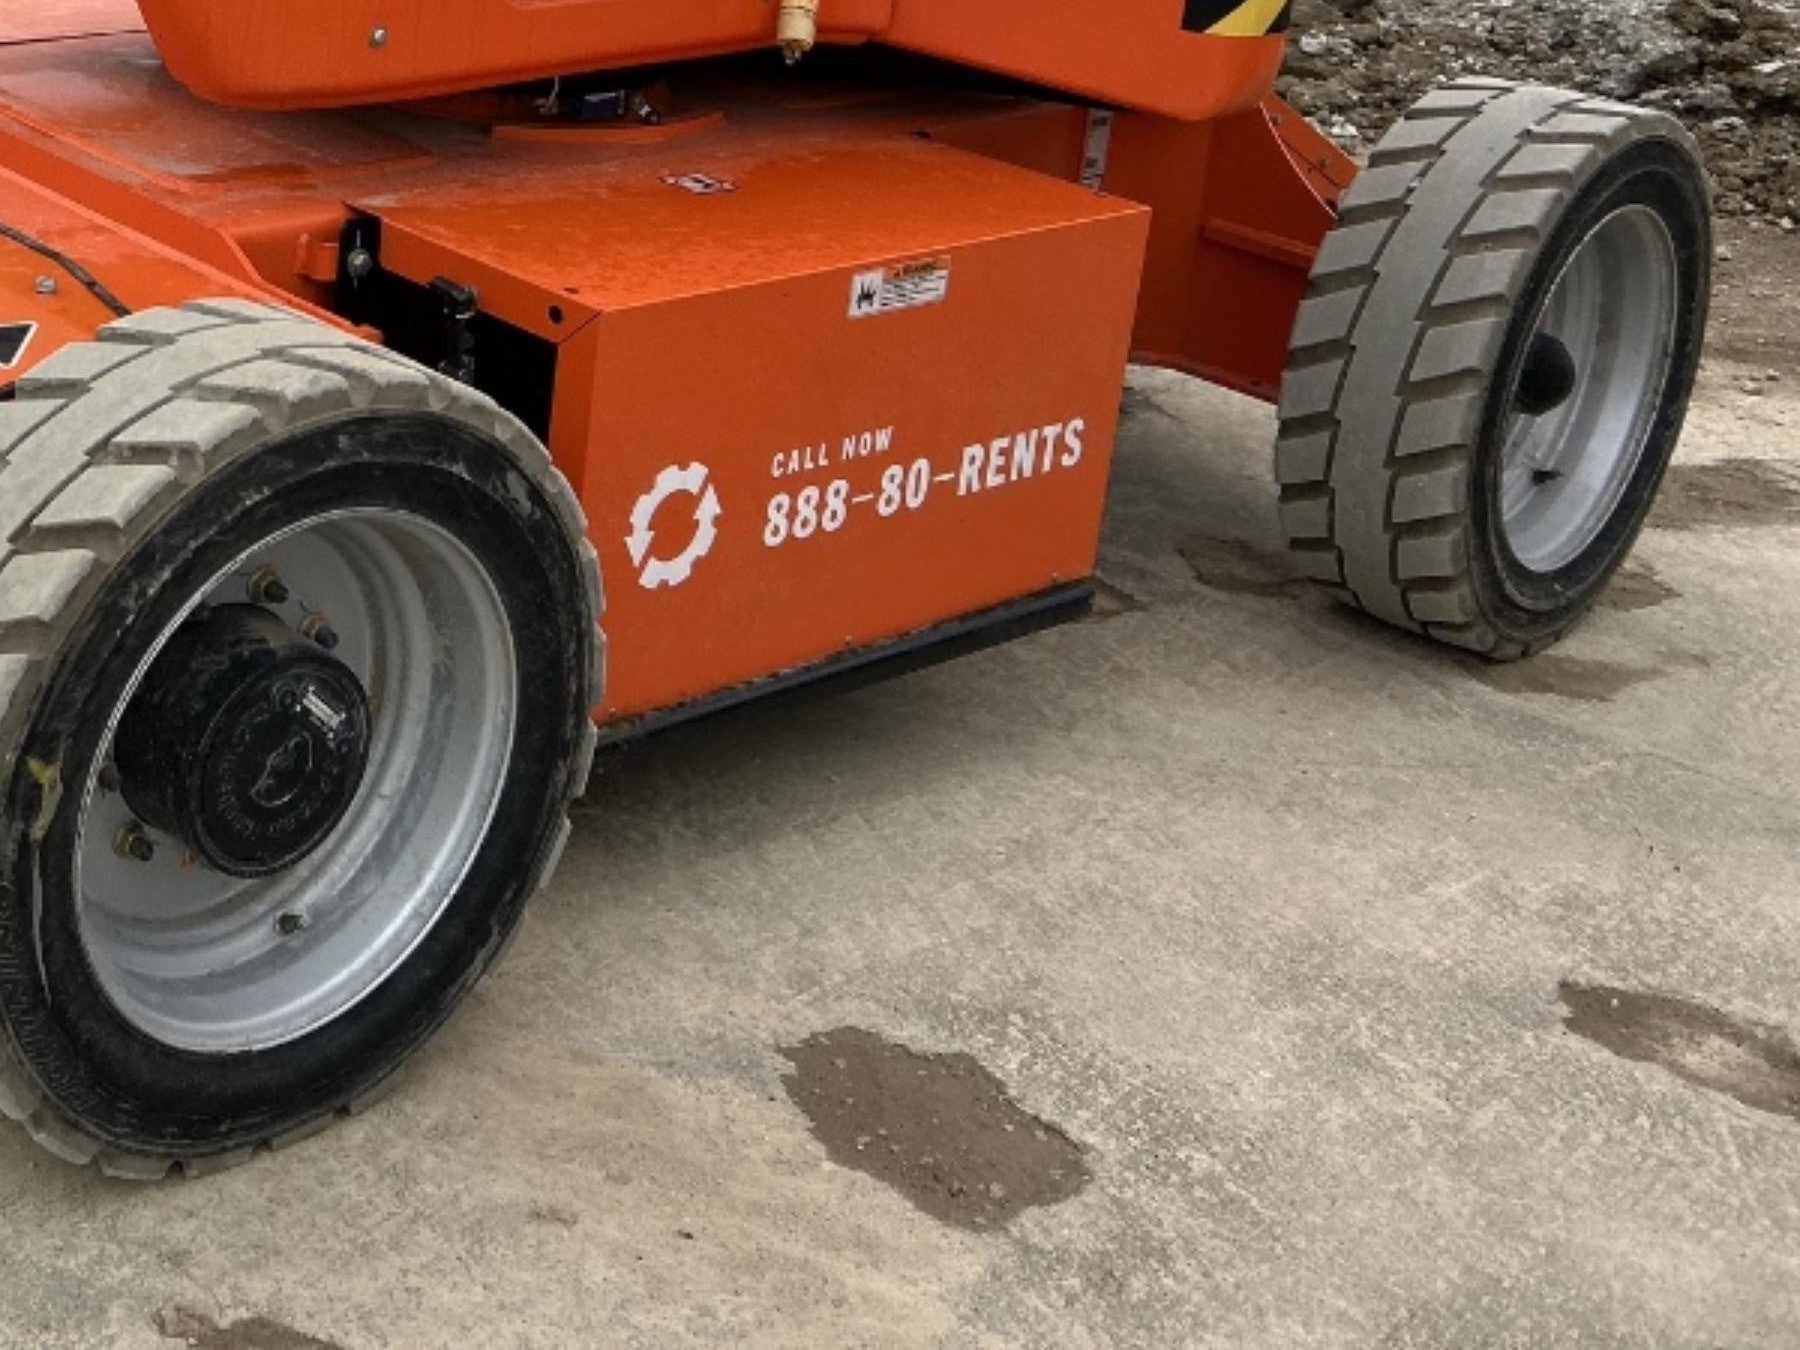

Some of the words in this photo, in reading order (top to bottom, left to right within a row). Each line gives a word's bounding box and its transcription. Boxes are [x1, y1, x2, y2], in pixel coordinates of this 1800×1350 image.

[762, 416, 1086, 547] 888-80-RENTS
[770, 443, 830, 478] CALL
[841, 425, 895, 461] NOW
